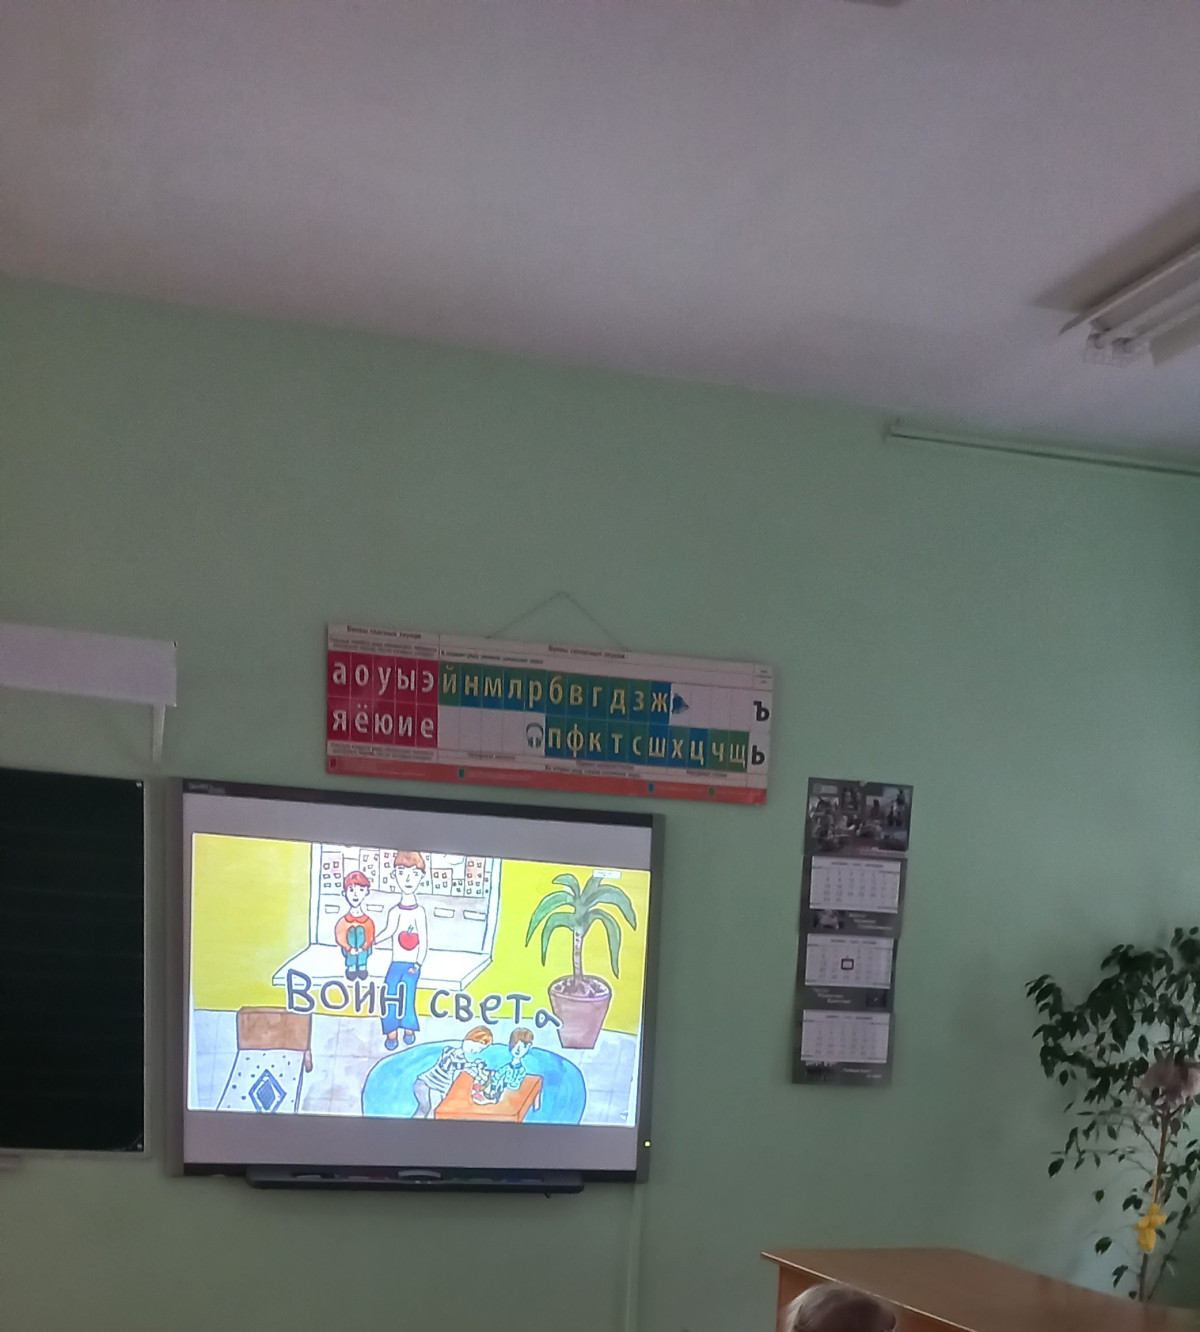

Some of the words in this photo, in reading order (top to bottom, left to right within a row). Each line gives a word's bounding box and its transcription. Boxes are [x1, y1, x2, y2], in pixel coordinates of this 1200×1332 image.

[333, 662, 346, 685] а
[355, 664, 369, 686] о
[378, 667, 391, 695] у
[398, 669, 415, 691] ы
[421, 671, 434, 693] э
[443, 665, 457, 694] й
[465, 674, 478, 697] н
[484, 676, 501, 697] м
[508, 678, 522, 699] л
[529, 679, 542, 708] р
[549, 675, 563, 705] б
[570, 684, 583, 705] в
[592, 686, 602, 707] г
[610, 689, 626, 715] д
[633, 691, 644, 711] з
[651, 692, 668, 713] ж
[333, 710, 347, 731] я
[355, 703, 369, 733] ё
[374, 713, 393, 735] ю
[398, 715, 412, 737] и
[421, 717, 434, 739] е
[548, 728, 561, 749] п
[567, 723, 584, 758] ф
[590, 732, 602, 752] к
[611, 733, 623, 754] т
[633, 736, 642, 756] с
[649, 737, 665, 758] ш
[671, 739, 683, 759] х
[691, 741, 704, 766] ц
[712, 742, 723, 762] ч
[730, 744, 746, 768] щ
[285, 969, 407, 1018] Воин
[429, 987, 563, 1030] света
